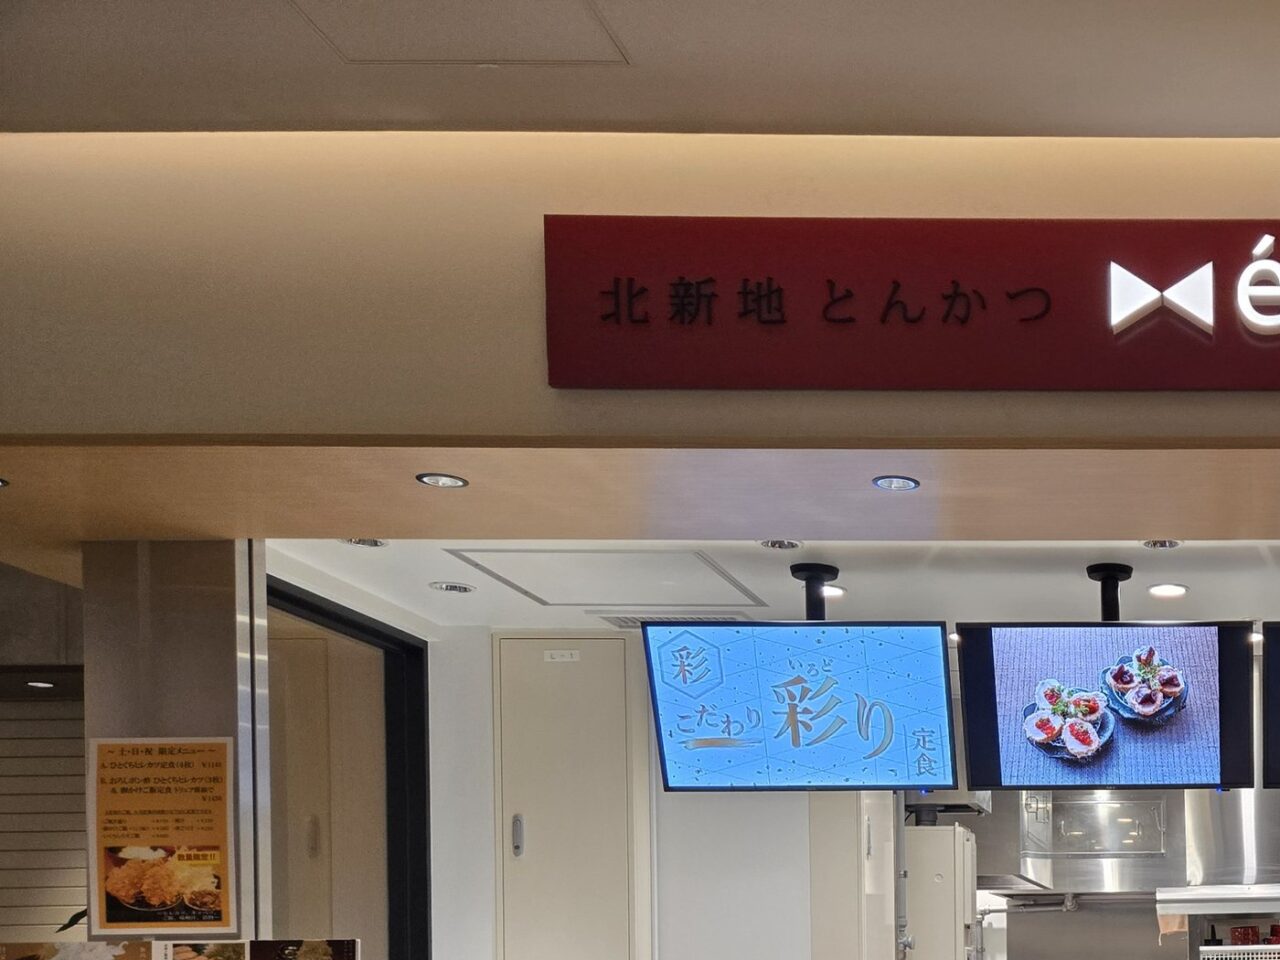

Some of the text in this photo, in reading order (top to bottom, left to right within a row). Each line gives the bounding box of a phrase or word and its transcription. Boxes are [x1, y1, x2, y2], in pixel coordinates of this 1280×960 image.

[600, 275, 1052, 326] 北新地 とんかつ
[671, 645, 711, 686] 彩
[788, 657, 835, 677] いろど
[677, 703, 761, 738] こだわり
[771, 674, 895, 760] 彩り
[911, 727, 938, 777] 定食
